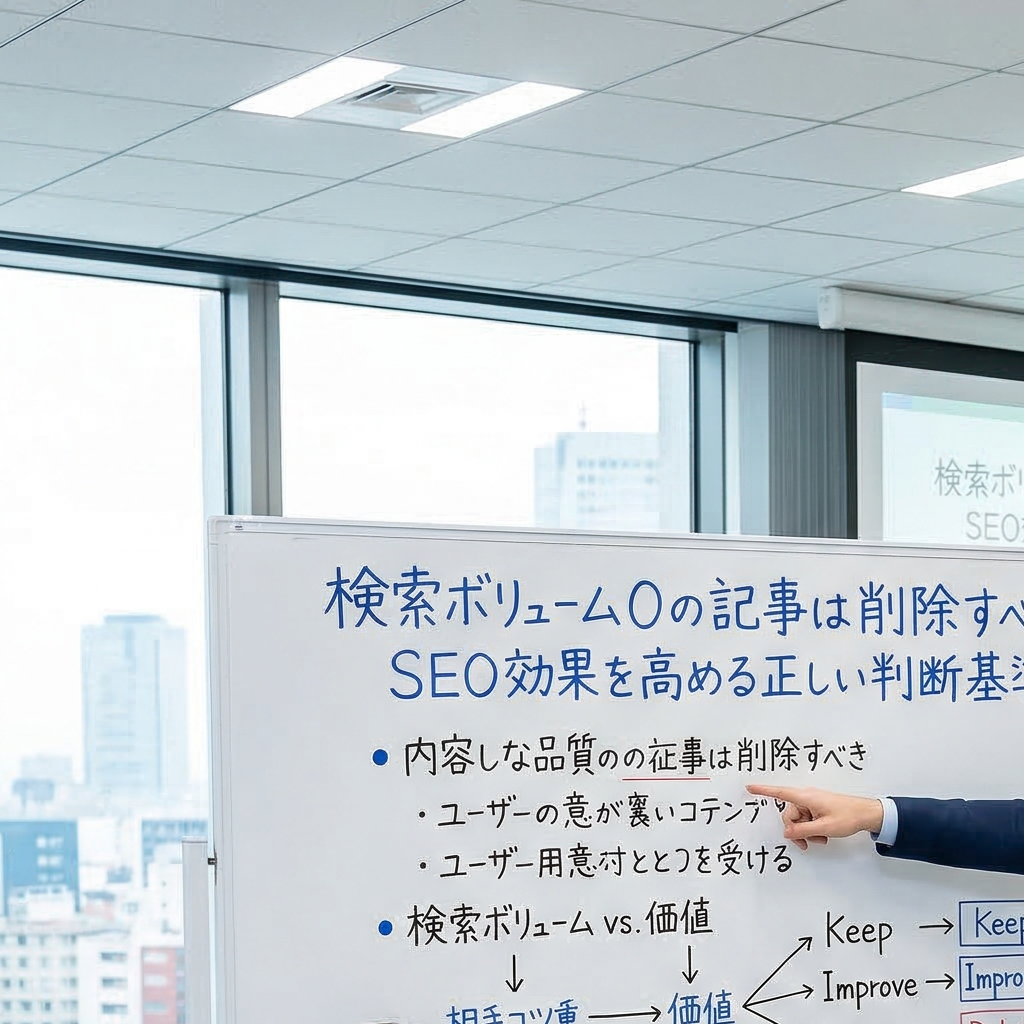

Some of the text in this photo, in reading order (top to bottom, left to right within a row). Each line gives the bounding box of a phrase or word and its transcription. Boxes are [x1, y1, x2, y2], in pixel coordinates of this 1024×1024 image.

[406, 903, 594, 947] 検索ボリューム
[645, 896, 714, 936] 価値
[826, 911, 893, 955] Keep
[822, 970, 918, 1010] Improve
